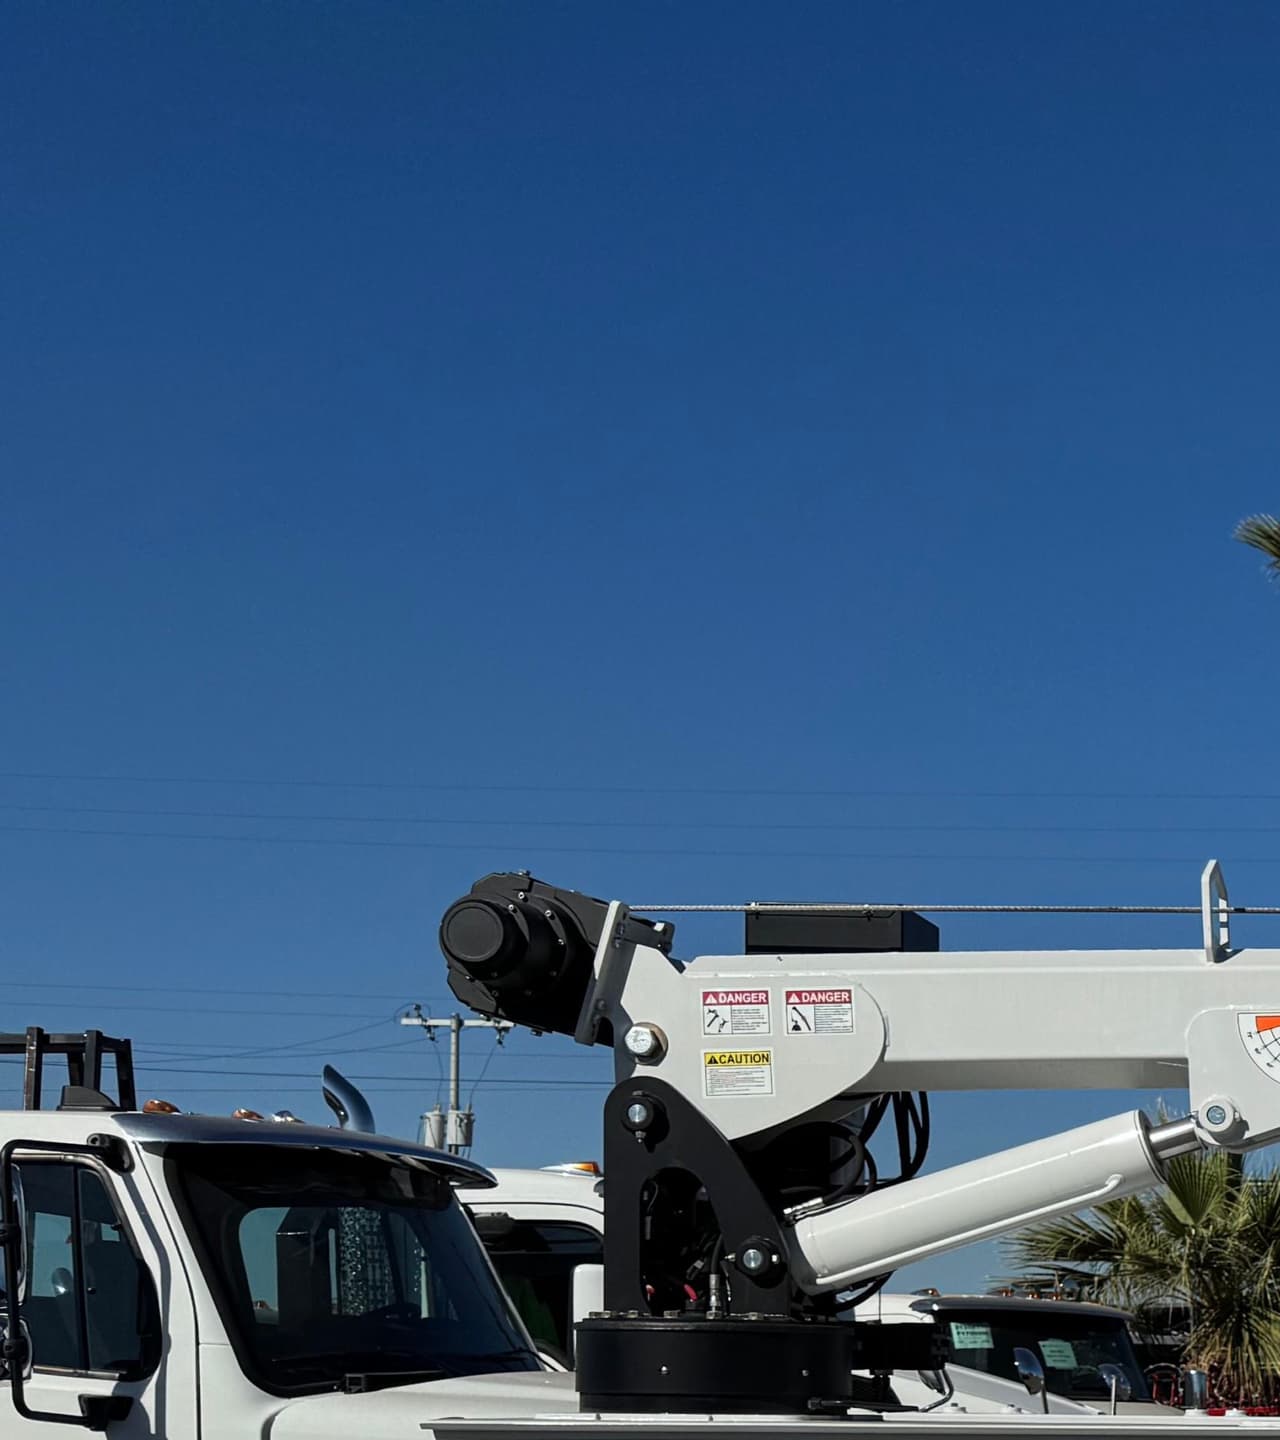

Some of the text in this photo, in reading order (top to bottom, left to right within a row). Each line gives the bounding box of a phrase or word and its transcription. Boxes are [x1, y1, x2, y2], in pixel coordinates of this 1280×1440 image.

[718, 992, 767, 1004] DANGER
[801, 991, 850, 1003] DANGER
[718, 1052, 770, 1065] CAUTION
